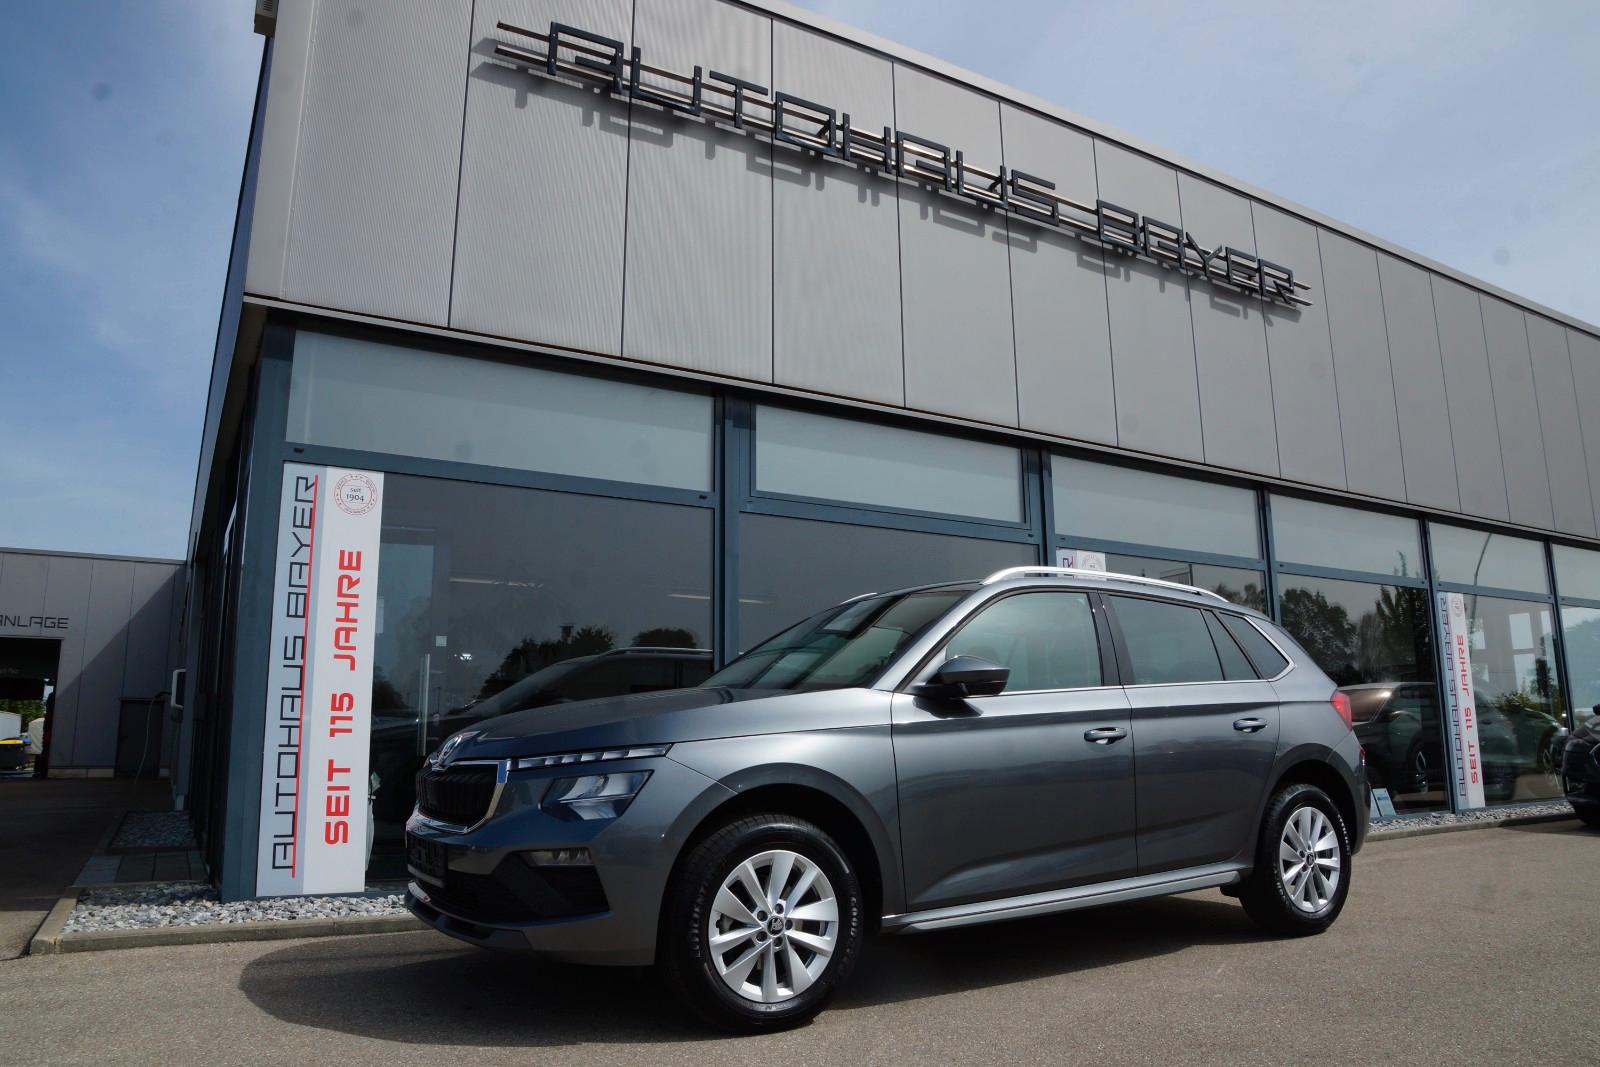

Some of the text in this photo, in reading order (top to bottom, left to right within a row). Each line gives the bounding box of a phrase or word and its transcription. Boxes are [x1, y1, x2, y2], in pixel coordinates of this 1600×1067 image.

[547, 22, 1295, 305] AUTOHAUS BAYER
[346, 493, 364, 502] 1904
[0, 614, 70, 629] NLAGE
[272, 475, 316, 870] AUTOHAUS BAYER
[324, 549, 362, 845] SEIT 115 JAHRE
[1456, 634, 1479, 785] SEIT 115 JAHRE
